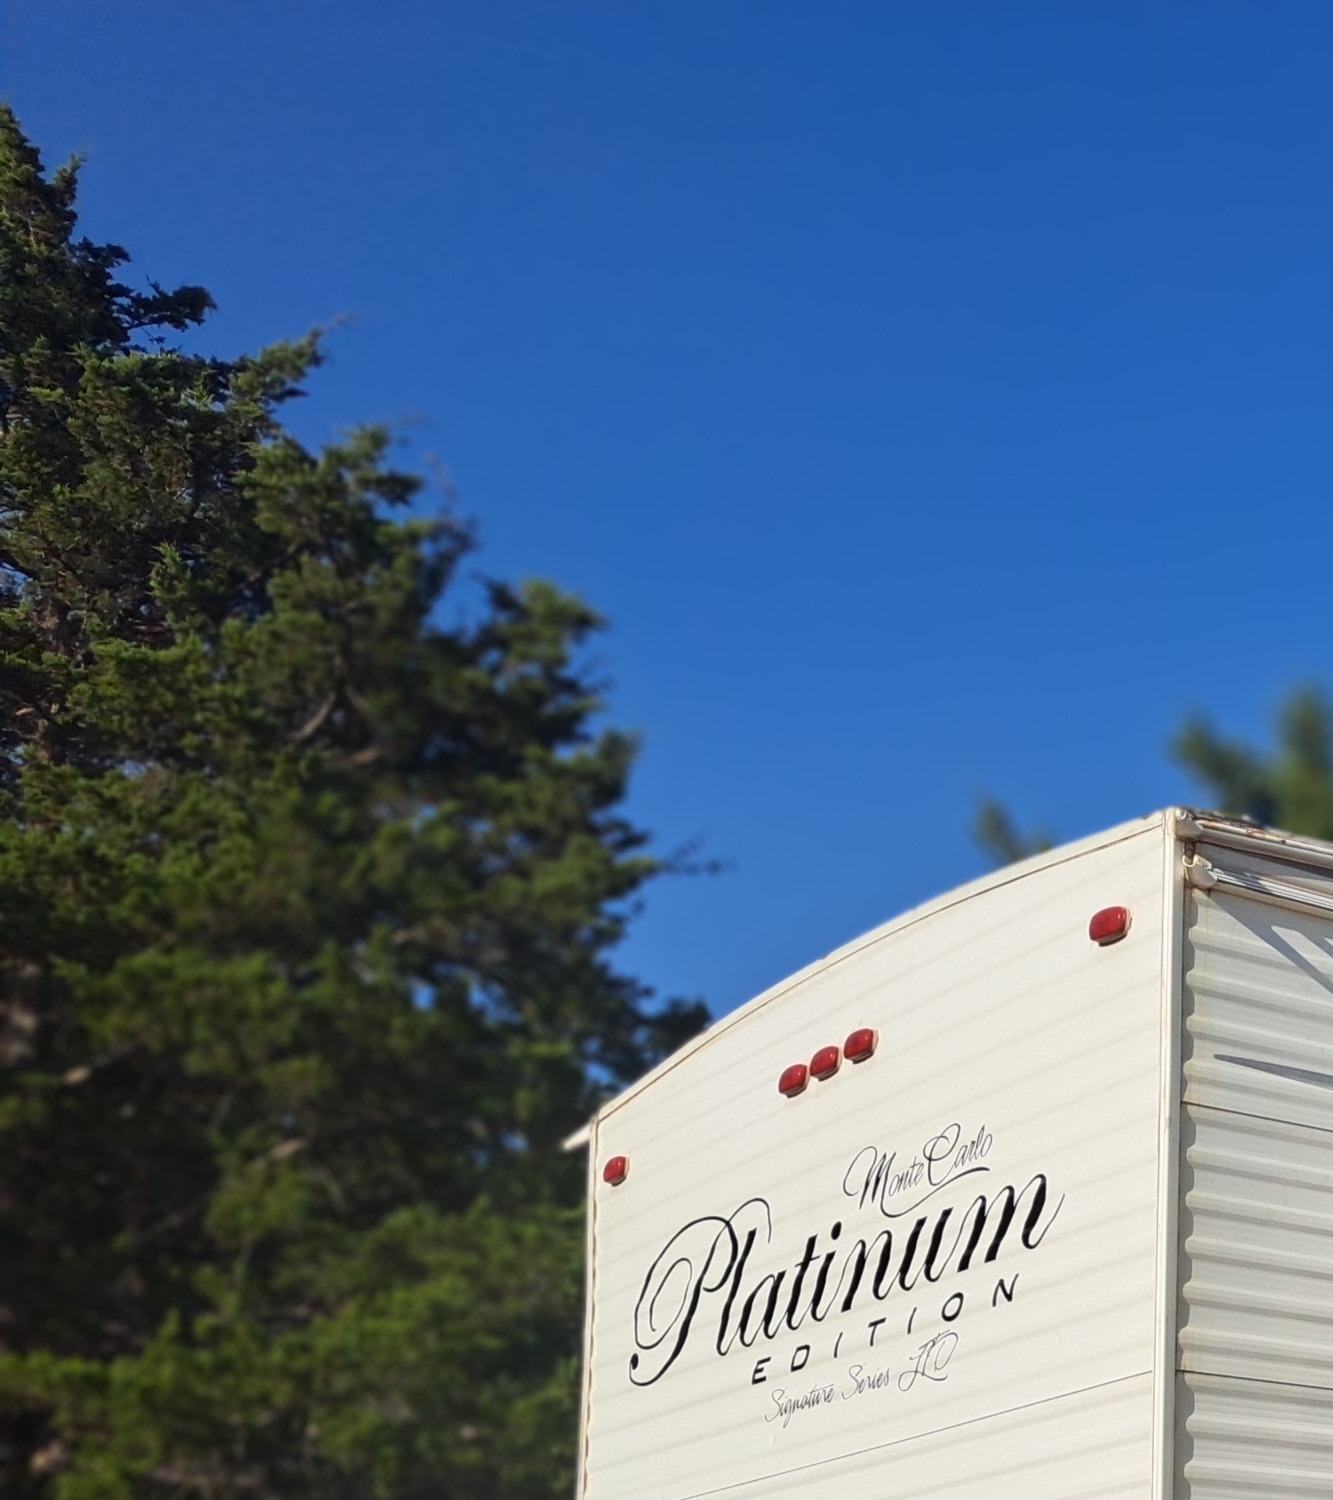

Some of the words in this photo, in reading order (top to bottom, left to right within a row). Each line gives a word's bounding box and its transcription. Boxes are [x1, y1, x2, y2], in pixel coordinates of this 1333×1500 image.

[843, 1146, 925, 1217] Monte
[922, 1123, 993, 1186] Carlo
[629, 1174, 1065, 1386] Platinum
[751, 1273, 1020, 1385] EDITION
[764, 1384, 837, 1429] Signature
[841, 1362, 890, 1400] Series
